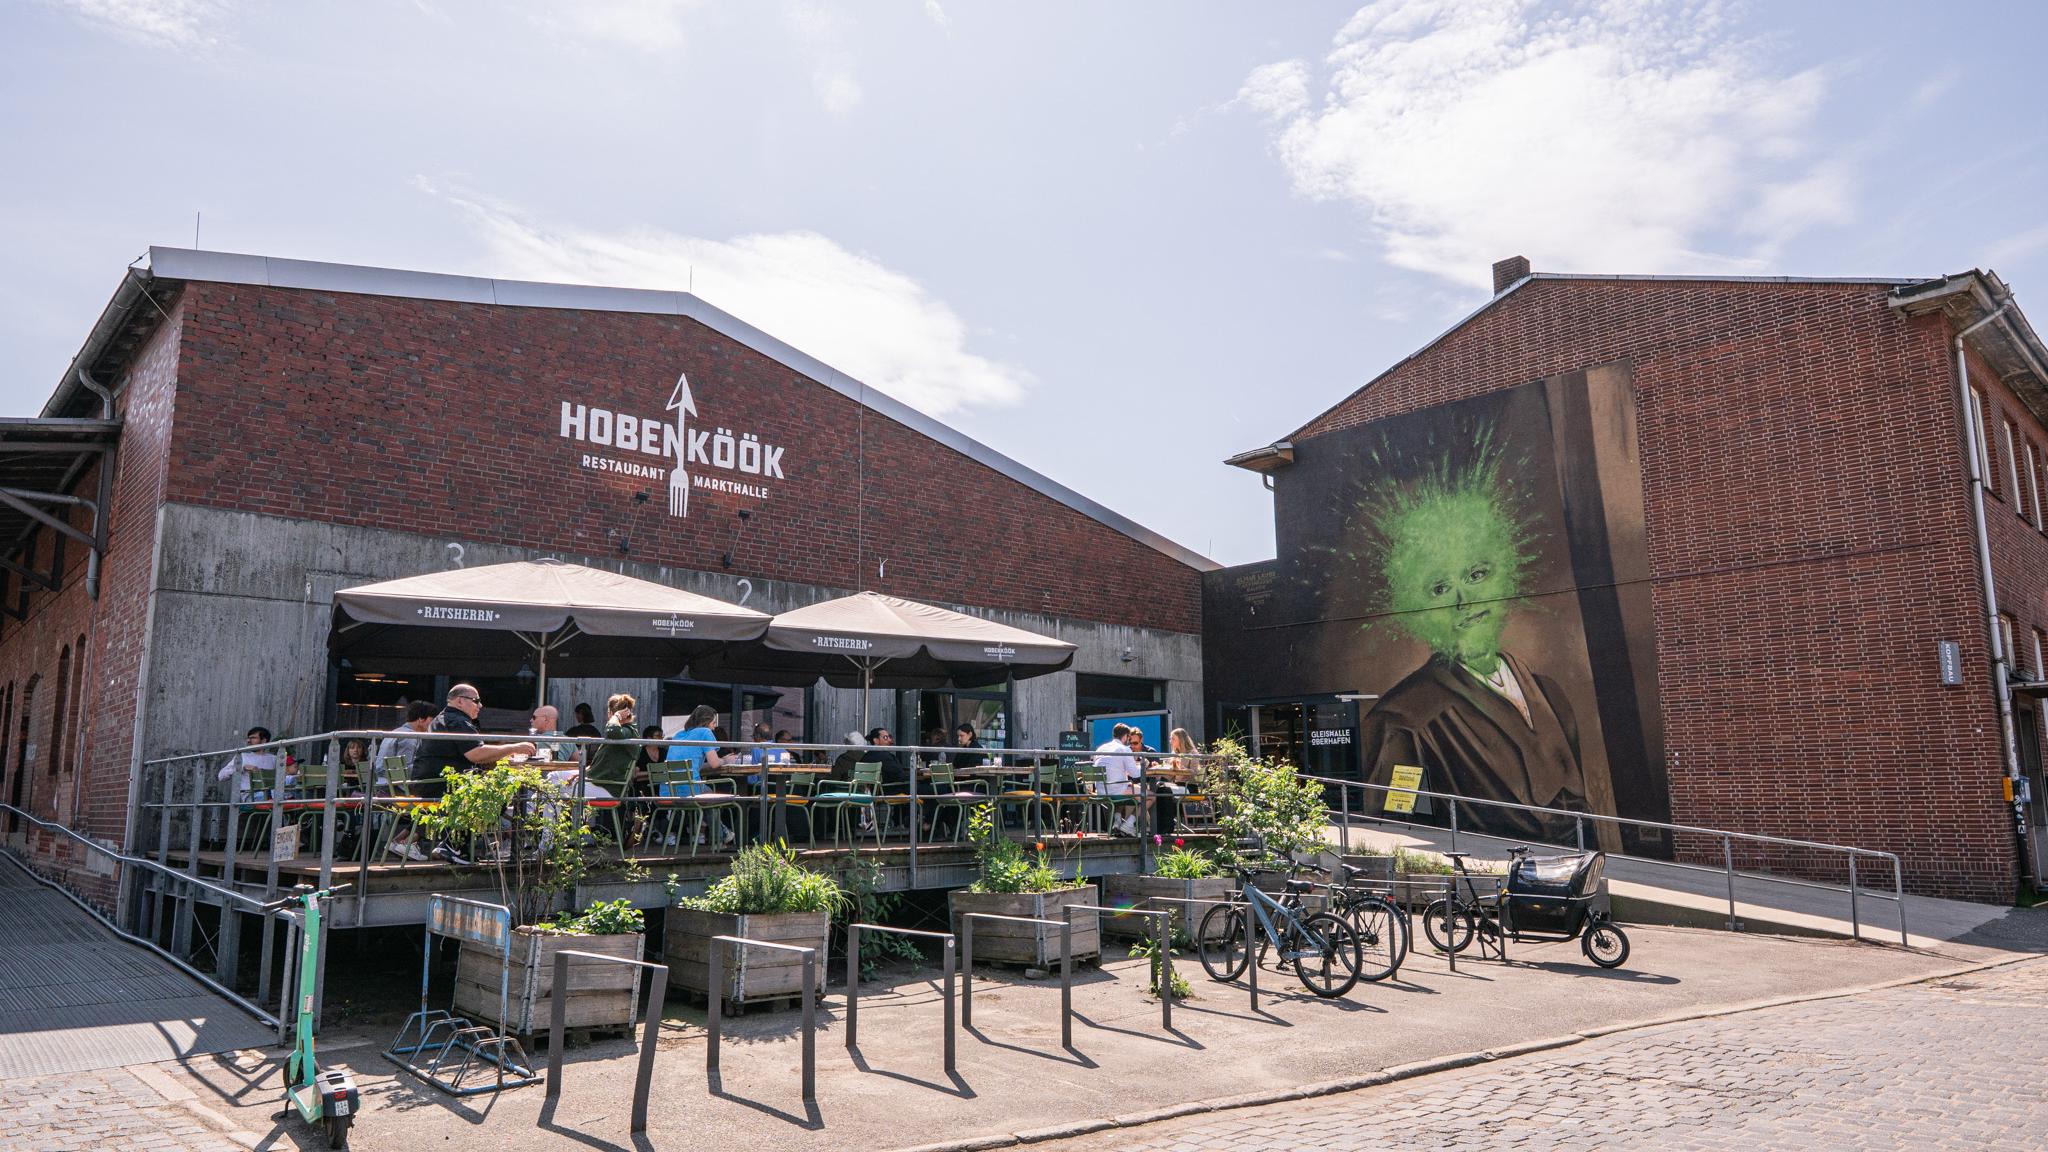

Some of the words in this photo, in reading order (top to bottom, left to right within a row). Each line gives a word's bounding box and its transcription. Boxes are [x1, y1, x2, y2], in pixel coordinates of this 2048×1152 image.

[560, 401, 785, 479] HOBENKÖÖK
[582, 454, 665, 481] RESTAURANT
[694, 475, 768, 499] MARKTHALLE
[423, 606, 494, 621] RATSHERRN
[817, 636, 868, 650] RATSHERRN
[1945, 643, 1954, 682] KOPFBAU
[1311, 729, 1351, 738] GLEISHALLE
[1311, 736, 1351, 746] OBERHAFEN
